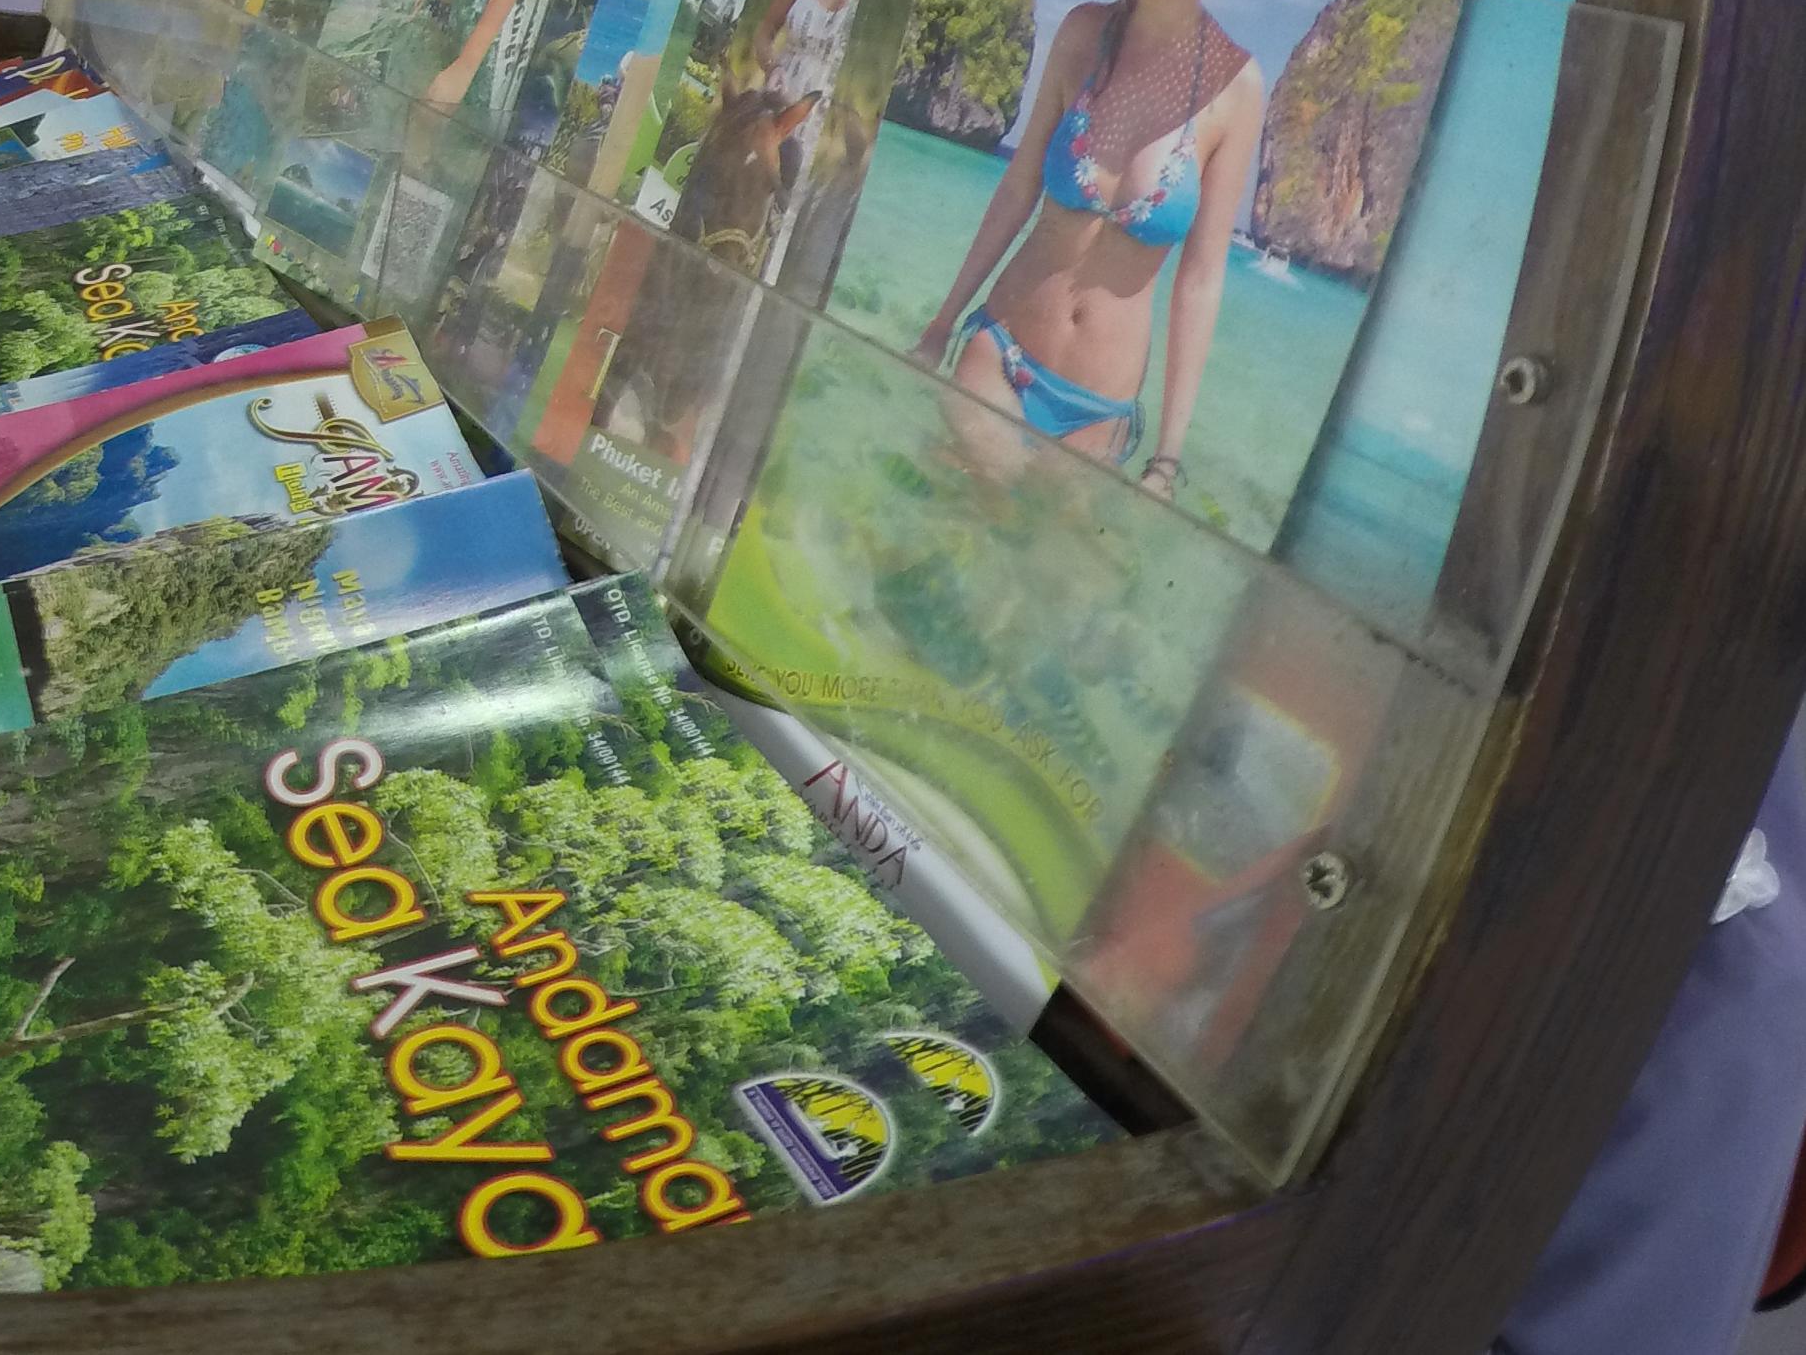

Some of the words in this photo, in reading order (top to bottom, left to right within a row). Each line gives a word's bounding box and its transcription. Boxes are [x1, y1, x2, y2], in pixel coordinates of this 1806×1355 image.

[589, 432, 664, 490] Phuket
[580, 476, 602, 502] The
[603, 493, 635, 519] Best
[619, 481, 639, 502] An
[606, 586, 634, 630] OTD.
[668, 706, 717, 759] 34/00144
[777, 667, 815, 698] YOU
[821, 672, 882, 703] MORE
[587, 731, 632, 786] 34/00144
[264, 736, 428, 944] Sea
[468, 888, 754, 1234] Andama
